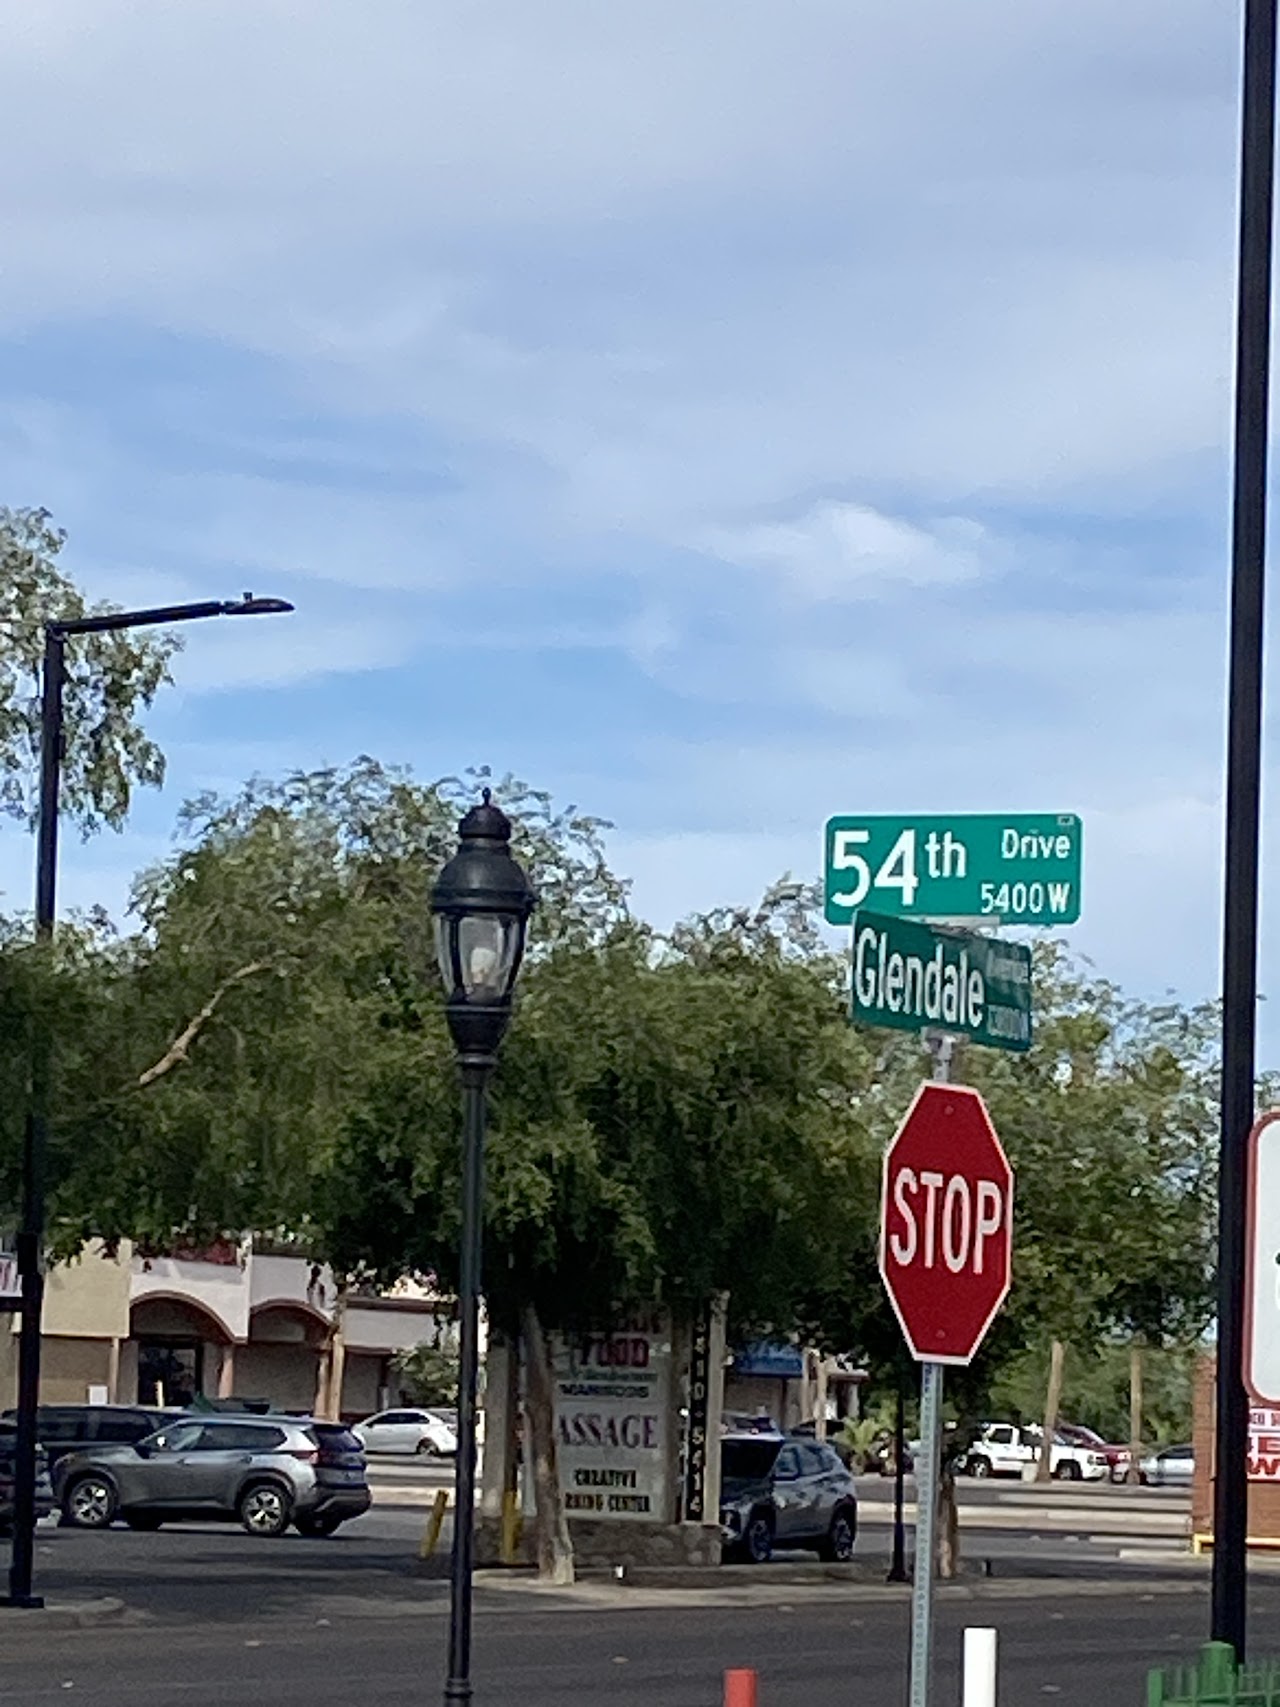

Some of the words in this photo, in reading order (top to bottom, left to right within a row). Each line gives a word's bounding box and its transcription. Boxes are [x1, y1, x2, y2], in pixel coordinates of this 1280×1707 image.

[831, 829, 967, 907] 54th
[1001, 828, 1071, 859] Drive
[854, 927, 985, 1028] Glendale
[889, 1167, 1002, 1275] STOP
[558, 1413, 658, 1449] ASSAGE
